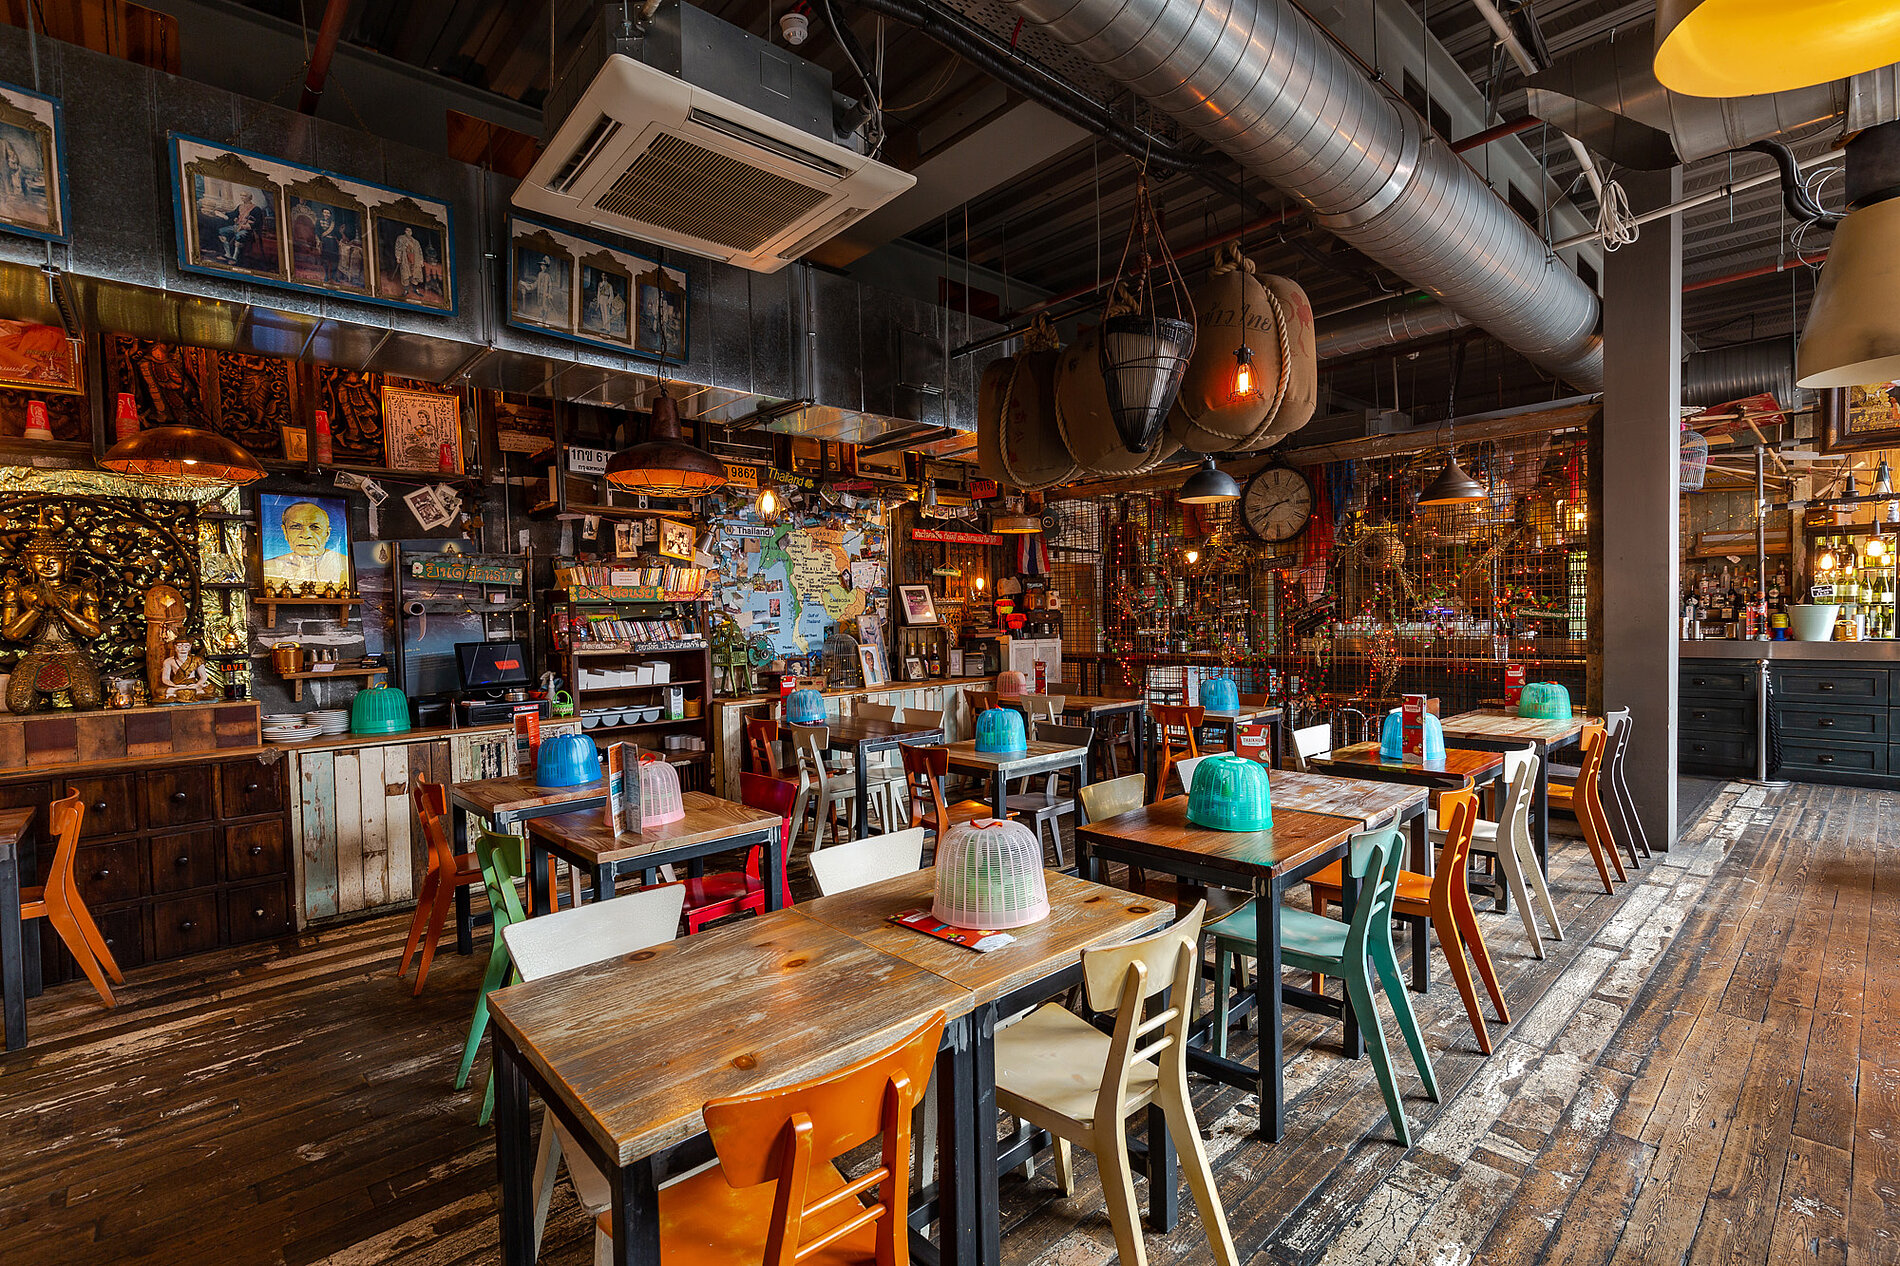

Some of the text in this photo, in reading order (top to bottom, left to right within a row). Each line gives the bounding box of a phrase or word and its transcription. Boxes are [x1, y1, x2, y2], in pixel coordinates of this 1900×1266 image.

[731, 466, 756, 480] 9862
[767, 466, 804, 487] Thailand
[736, 526, 770, 536] Thailand
